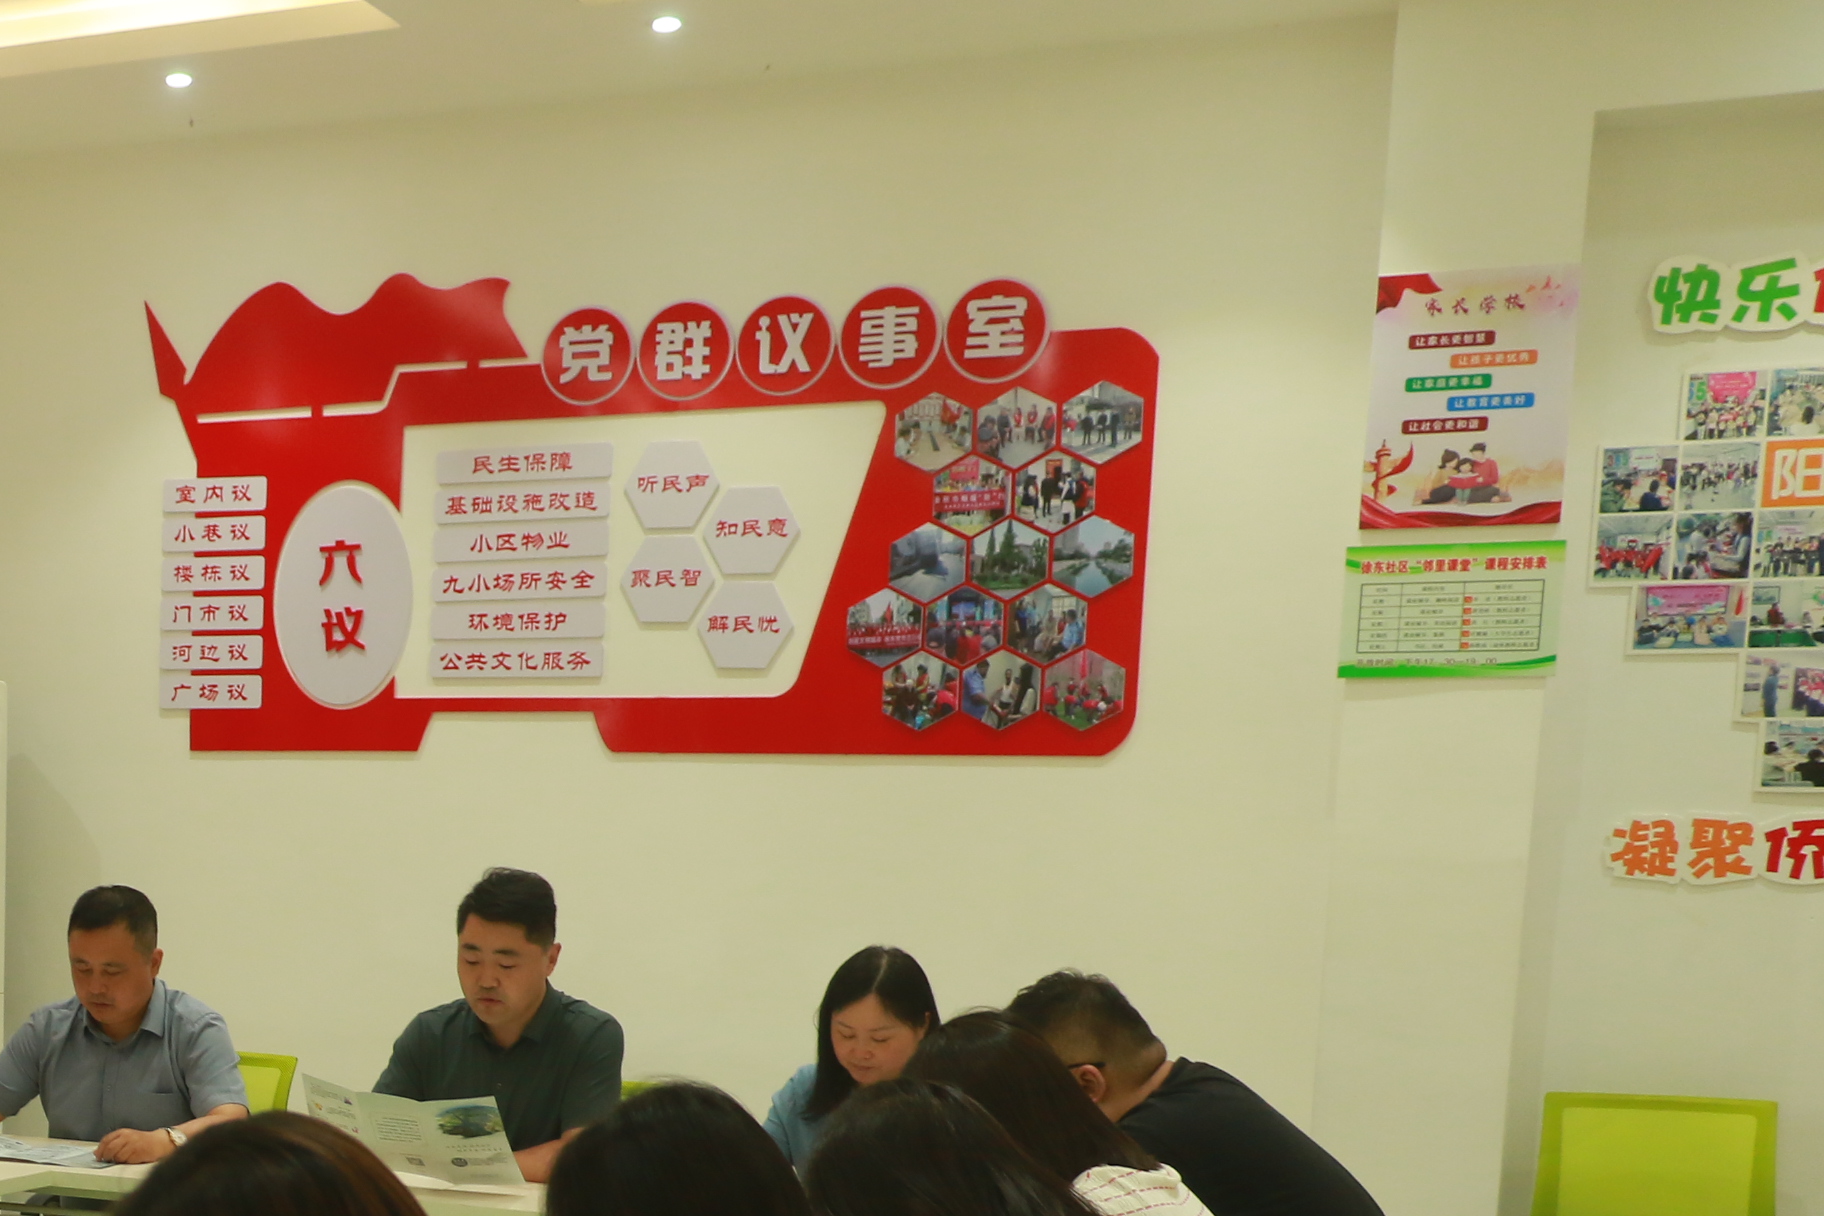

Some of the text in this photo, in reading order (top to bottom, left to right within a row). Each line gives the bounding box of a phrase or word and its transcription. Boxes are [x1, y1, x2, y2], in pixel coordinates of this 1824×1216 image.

[1654, 257, 1824, 326] 快乐
[557, 294, 1029, 384] 党群议事室
[1415, 332, 1487, 348] 让家长更智慧
[471, 451, 575, 476] 民生保障
[175, 483, 254, 506] 室内议
[636, 471, 711, 496] 听民声
[443, 490, 600, 517] 基础设施改造
[173, 522, 253, 545] 小巷议
[715, 516, 790, 541] 知民意
[469, 530, 571, 555] 小区物业
[173, 562, 252, 585] 楼栋议
[1484, 556, 1549, 571] 课程安排表
[441, 568, 597, 595] 九小场所安全
[629, 566, 703, 590] 聚民智
[318, 538, 368, 655] 六议
[172, 602, 250, 626] 门市议
[467, 610, 569, 634] 环境保护
[705, 612, 782, 637] 解民忧
[172, 642, 249, 666] 河边议
[439, 649, 593, 674] 公共文化服务
[172, 681, 249, 705] 广场议
